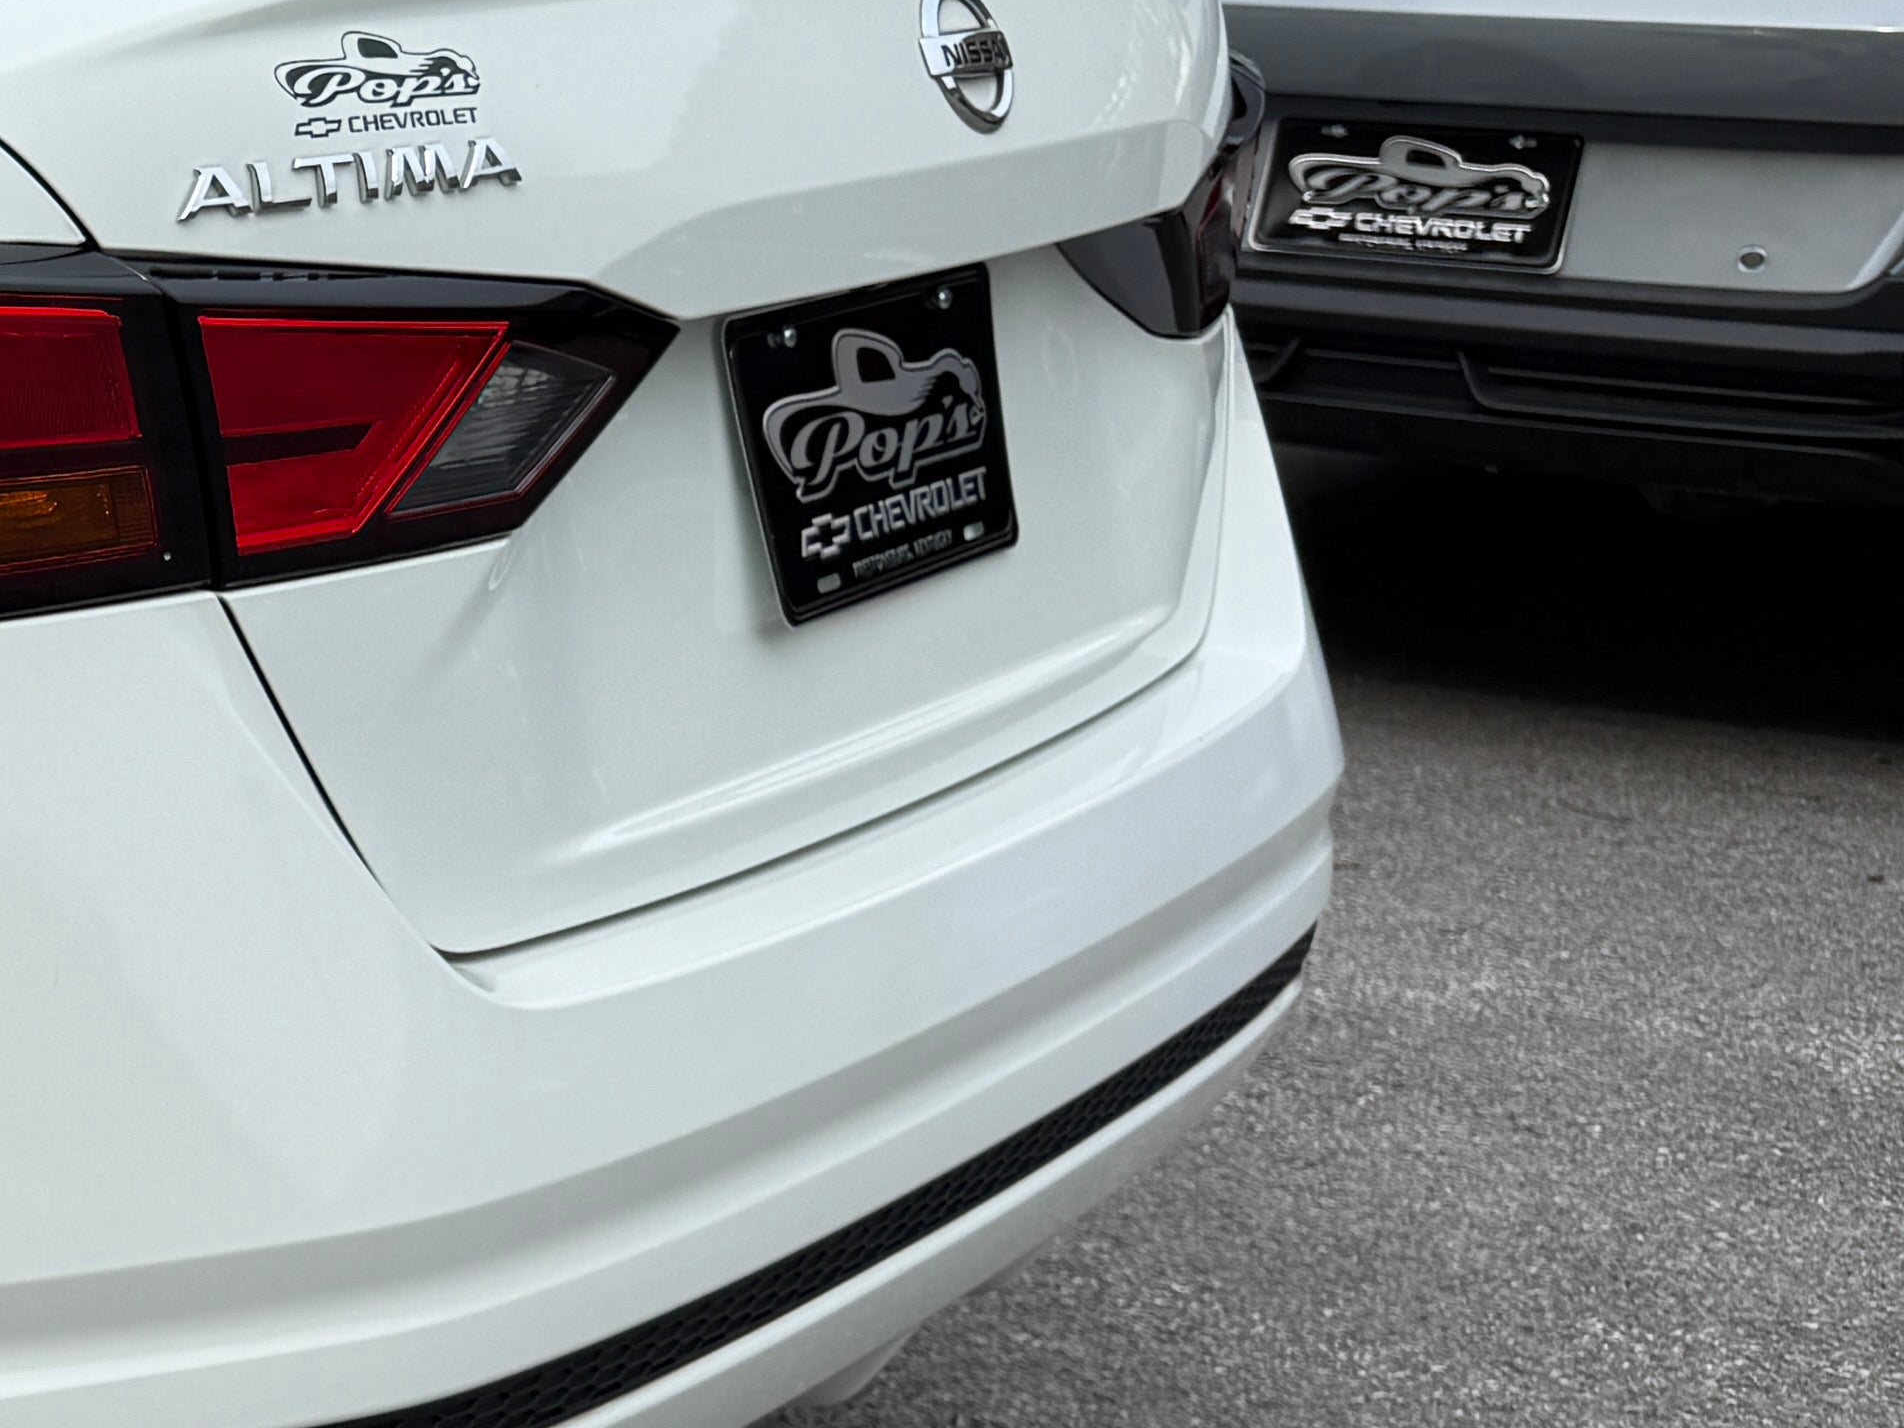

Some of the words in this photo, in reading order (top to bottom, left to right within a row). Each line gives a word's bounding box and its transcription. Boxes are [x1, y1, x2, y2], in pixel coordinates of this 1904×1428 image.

[941, 39, 1007, 67] NISSA
[293, 64, 474, 108] Pop's
[348, 107, 478, 133] CHEVROLET
[176, 138, 523, 223] ALTIMA
[1354, 212, 1532, 244] CHEVROLET
[790, 395, 979, 487] Pop's
[853, 466, 988, 541] CHEVROLET
